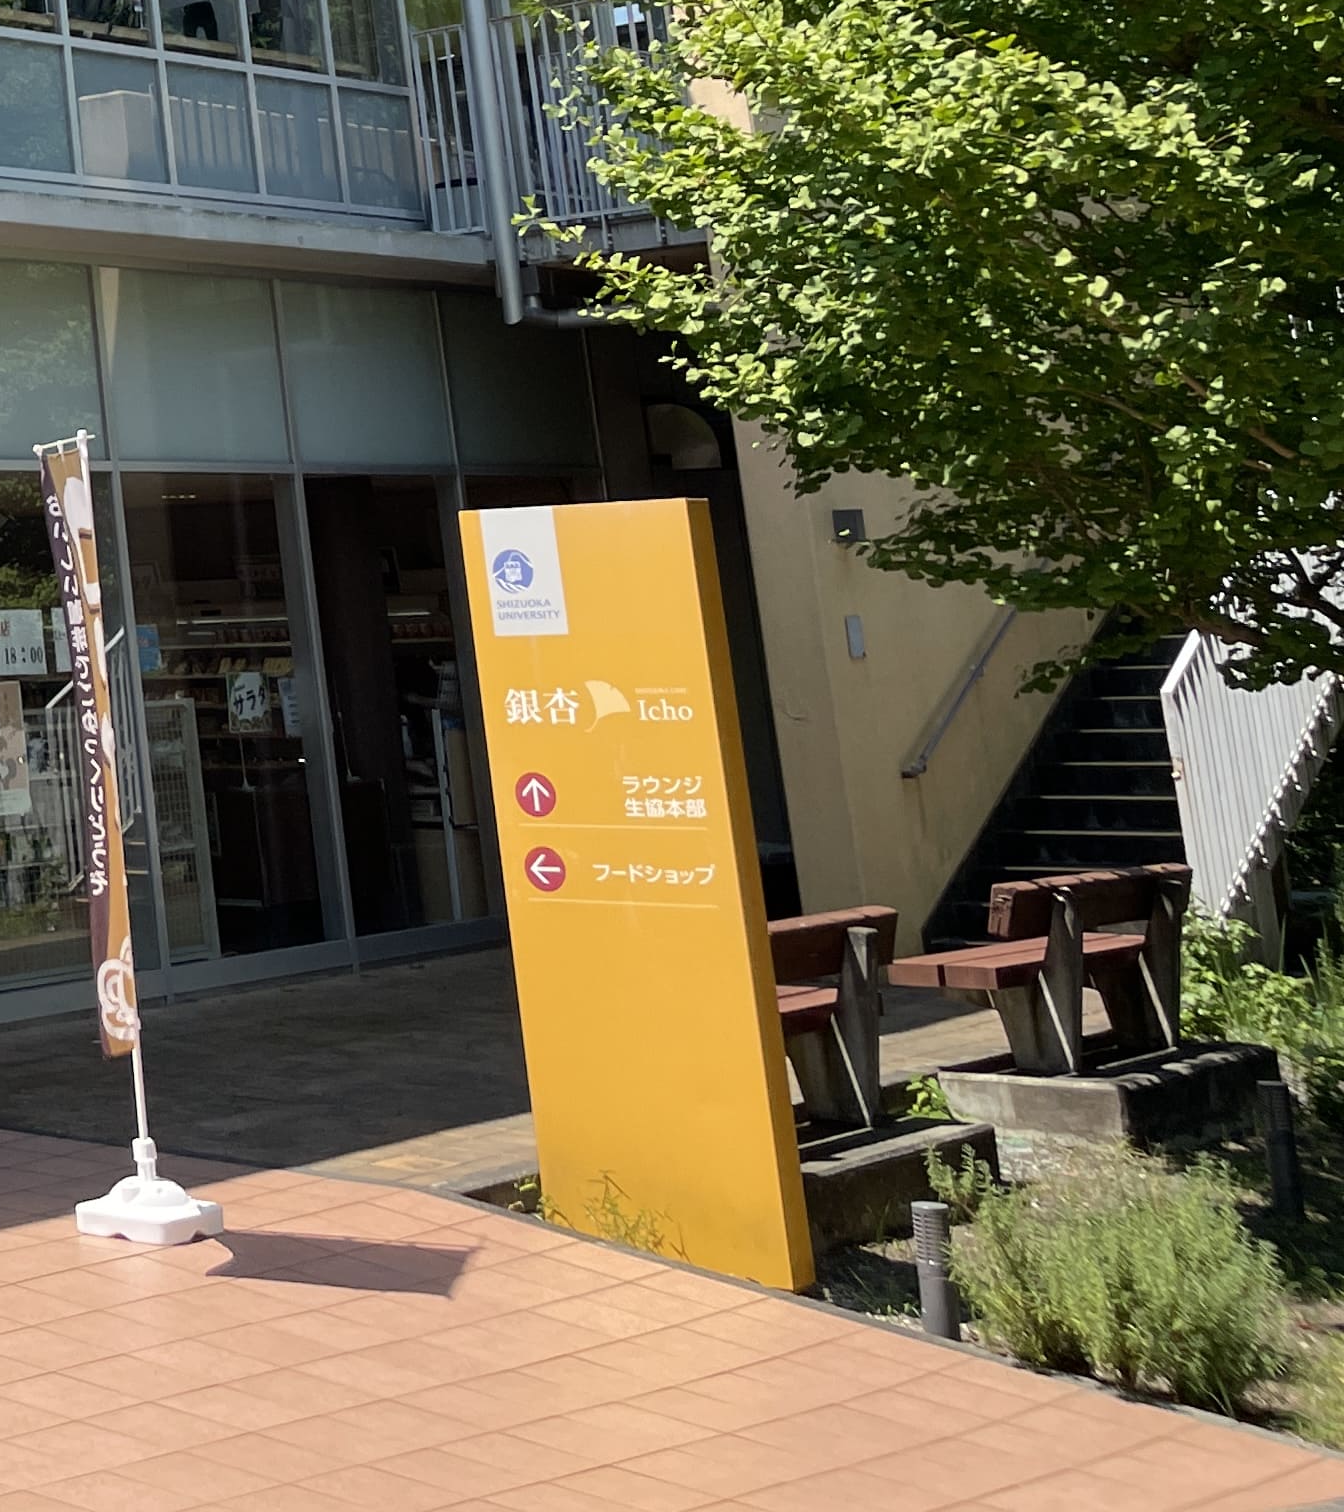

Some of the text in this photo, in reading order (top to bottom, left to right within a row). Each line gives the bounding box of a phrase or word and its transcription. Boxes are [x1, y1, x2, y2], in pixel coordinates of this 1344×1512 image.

[496, 598, 551, 610] SHIZUOKA
[498, 609, 560, 621] UNIVERSITY
[504, 687, 580, 725] 銀杏
[637, 698, 693, 722] Icho
[622, 775, 703, 795] ラウンジ
[624, 798, 708, 819] 生協本部
[593, 863, 716, 886] フードショップ
